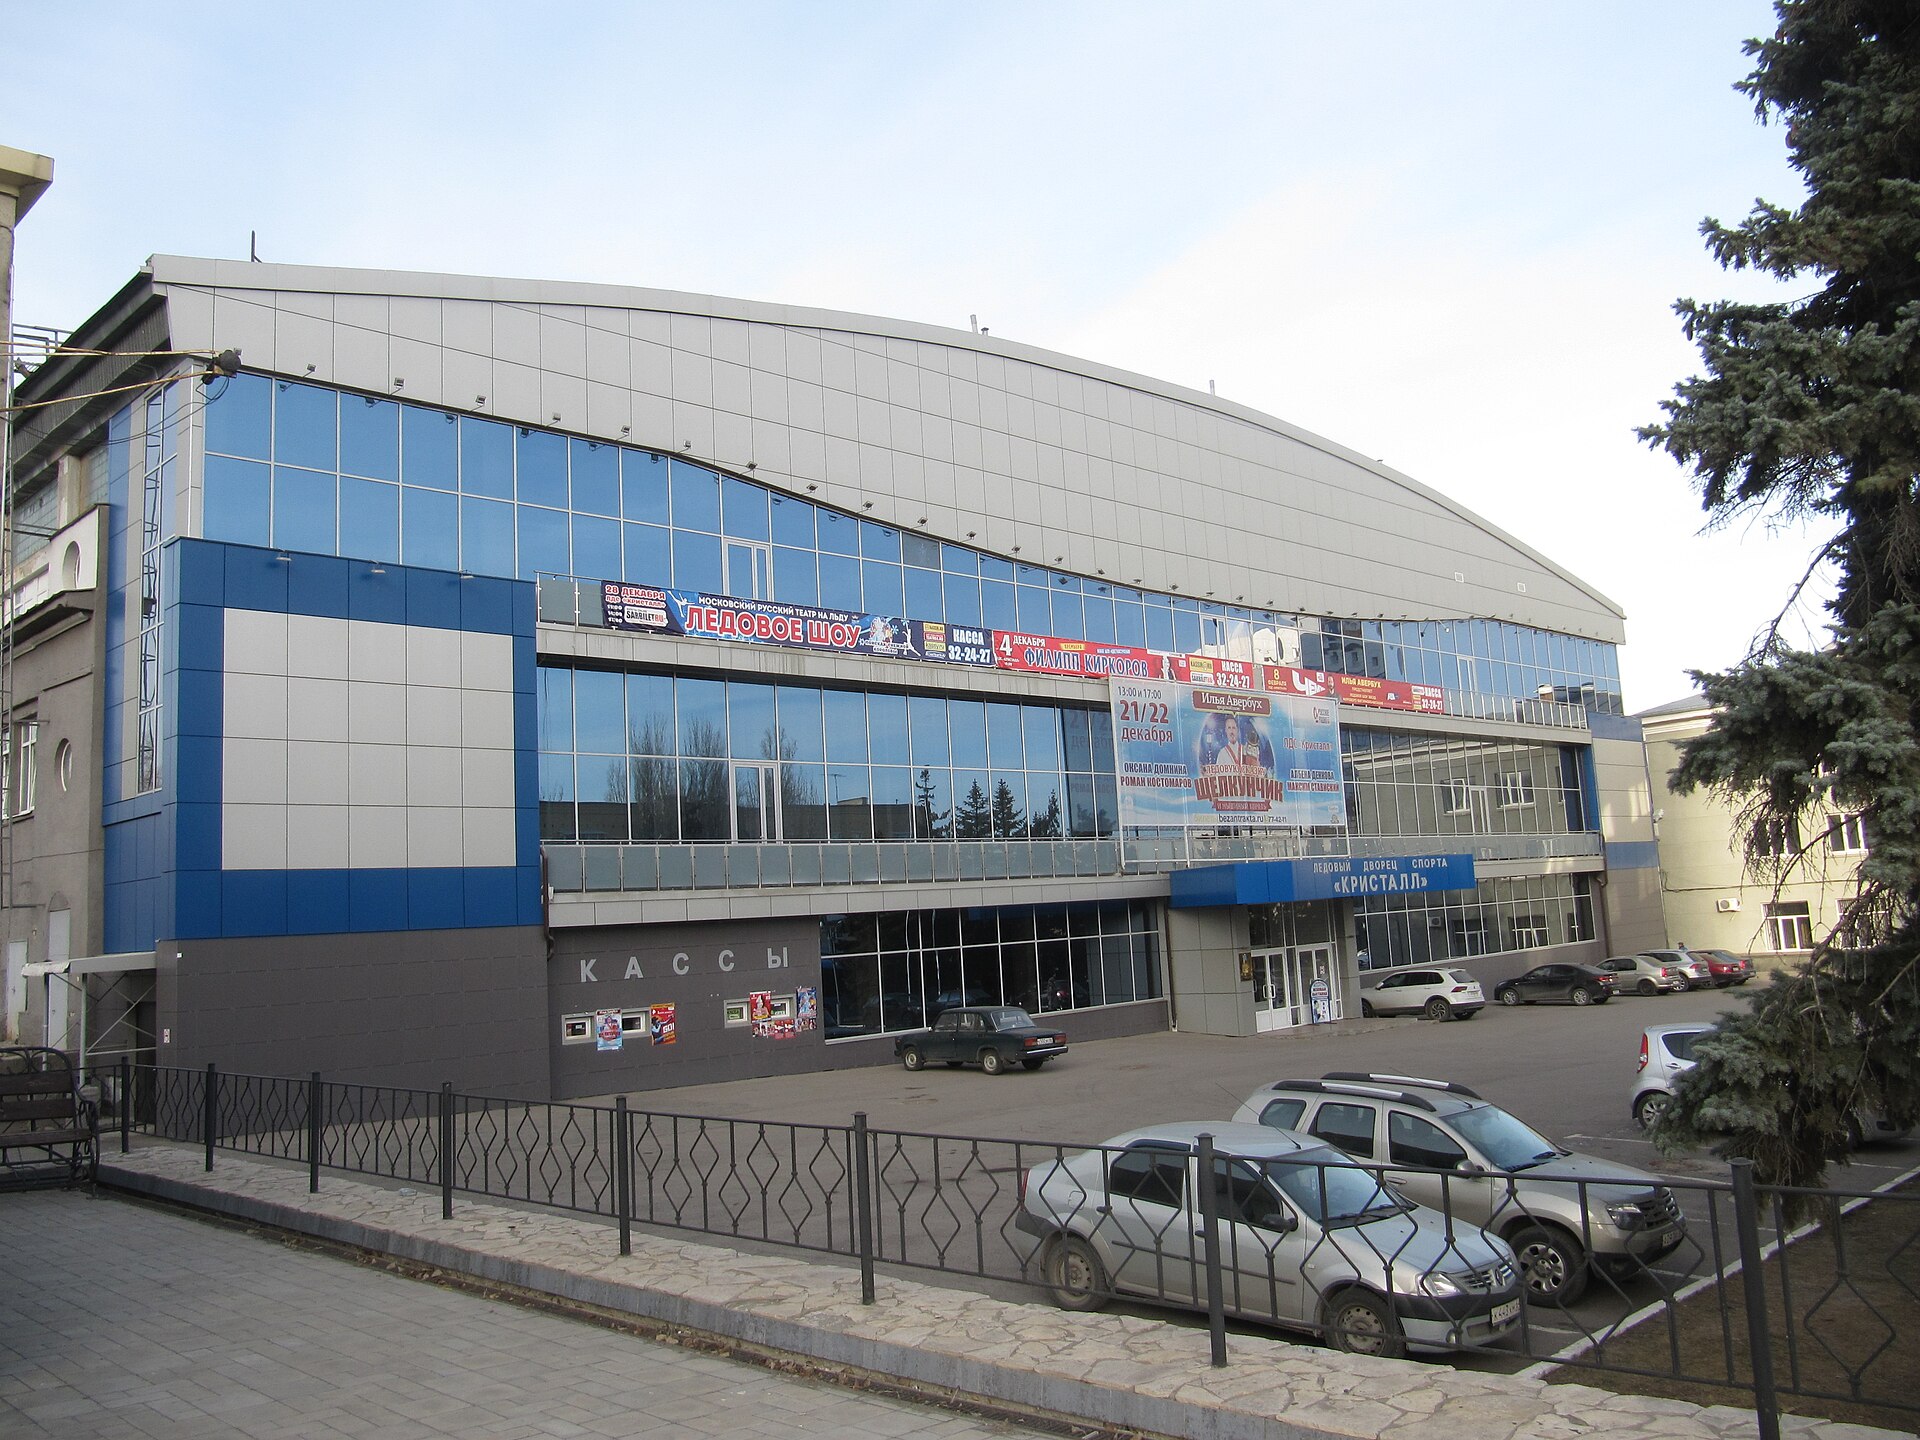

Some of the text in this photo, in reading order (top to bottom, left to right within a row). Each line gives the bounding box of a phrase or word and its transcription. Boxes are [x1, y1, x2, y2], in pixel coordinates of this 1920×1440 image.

[605, 585, 666, 600] 28 ДЕКАБРЯ
[699, 597, 849, 623] МОСКОВСКИЙ РУССКИЙ ТЕАТР НА ЛЬДУ
[685, 605, 862, 648] ЛЕДОВОЕ ШОУ
[953, 629, 985, 645] КАССА
[1000, 634, 1046, 656] 4 ДЕКАБРЯ
[948, 645, 991, 664] 32-24-27
[1024, 647, 1149, 678] ФИЛИПП КИРКОРОВ
[1221, 660, 1243, 673] КАССА
[1273, 669, 1280, 680] 8
[1216, 672, 1250, 688] 32-24-27
[1357, 679, 1381, 689] АВЕРБУХ
[1118, 686, 1137, 697] 13:00
[1143, 688, 1161, 699] 17:00
[1201, 692, 1262, 711] Илья Авербух
[1120, 700, 1169, 724] 21/22
[1121, 725, 1173, 746] декабря
[1124, 762, 1187, 775] ОКСАНА ДОМНИНА
[1120, 776, 1192, 788] РОМАН КОСТОМАРОВ
[1195, 775, 1283, 802] ЩЕЛКУНЧИК
[1218, 813, 1264, 823] bezantrakta.ru
[1313, 858, 1448, 873] ЛЕДОВЫЙ ДВОРЕЦ СПОРТА
[1334, 872, 1428, 893] «КРИСТАЛЛ»
